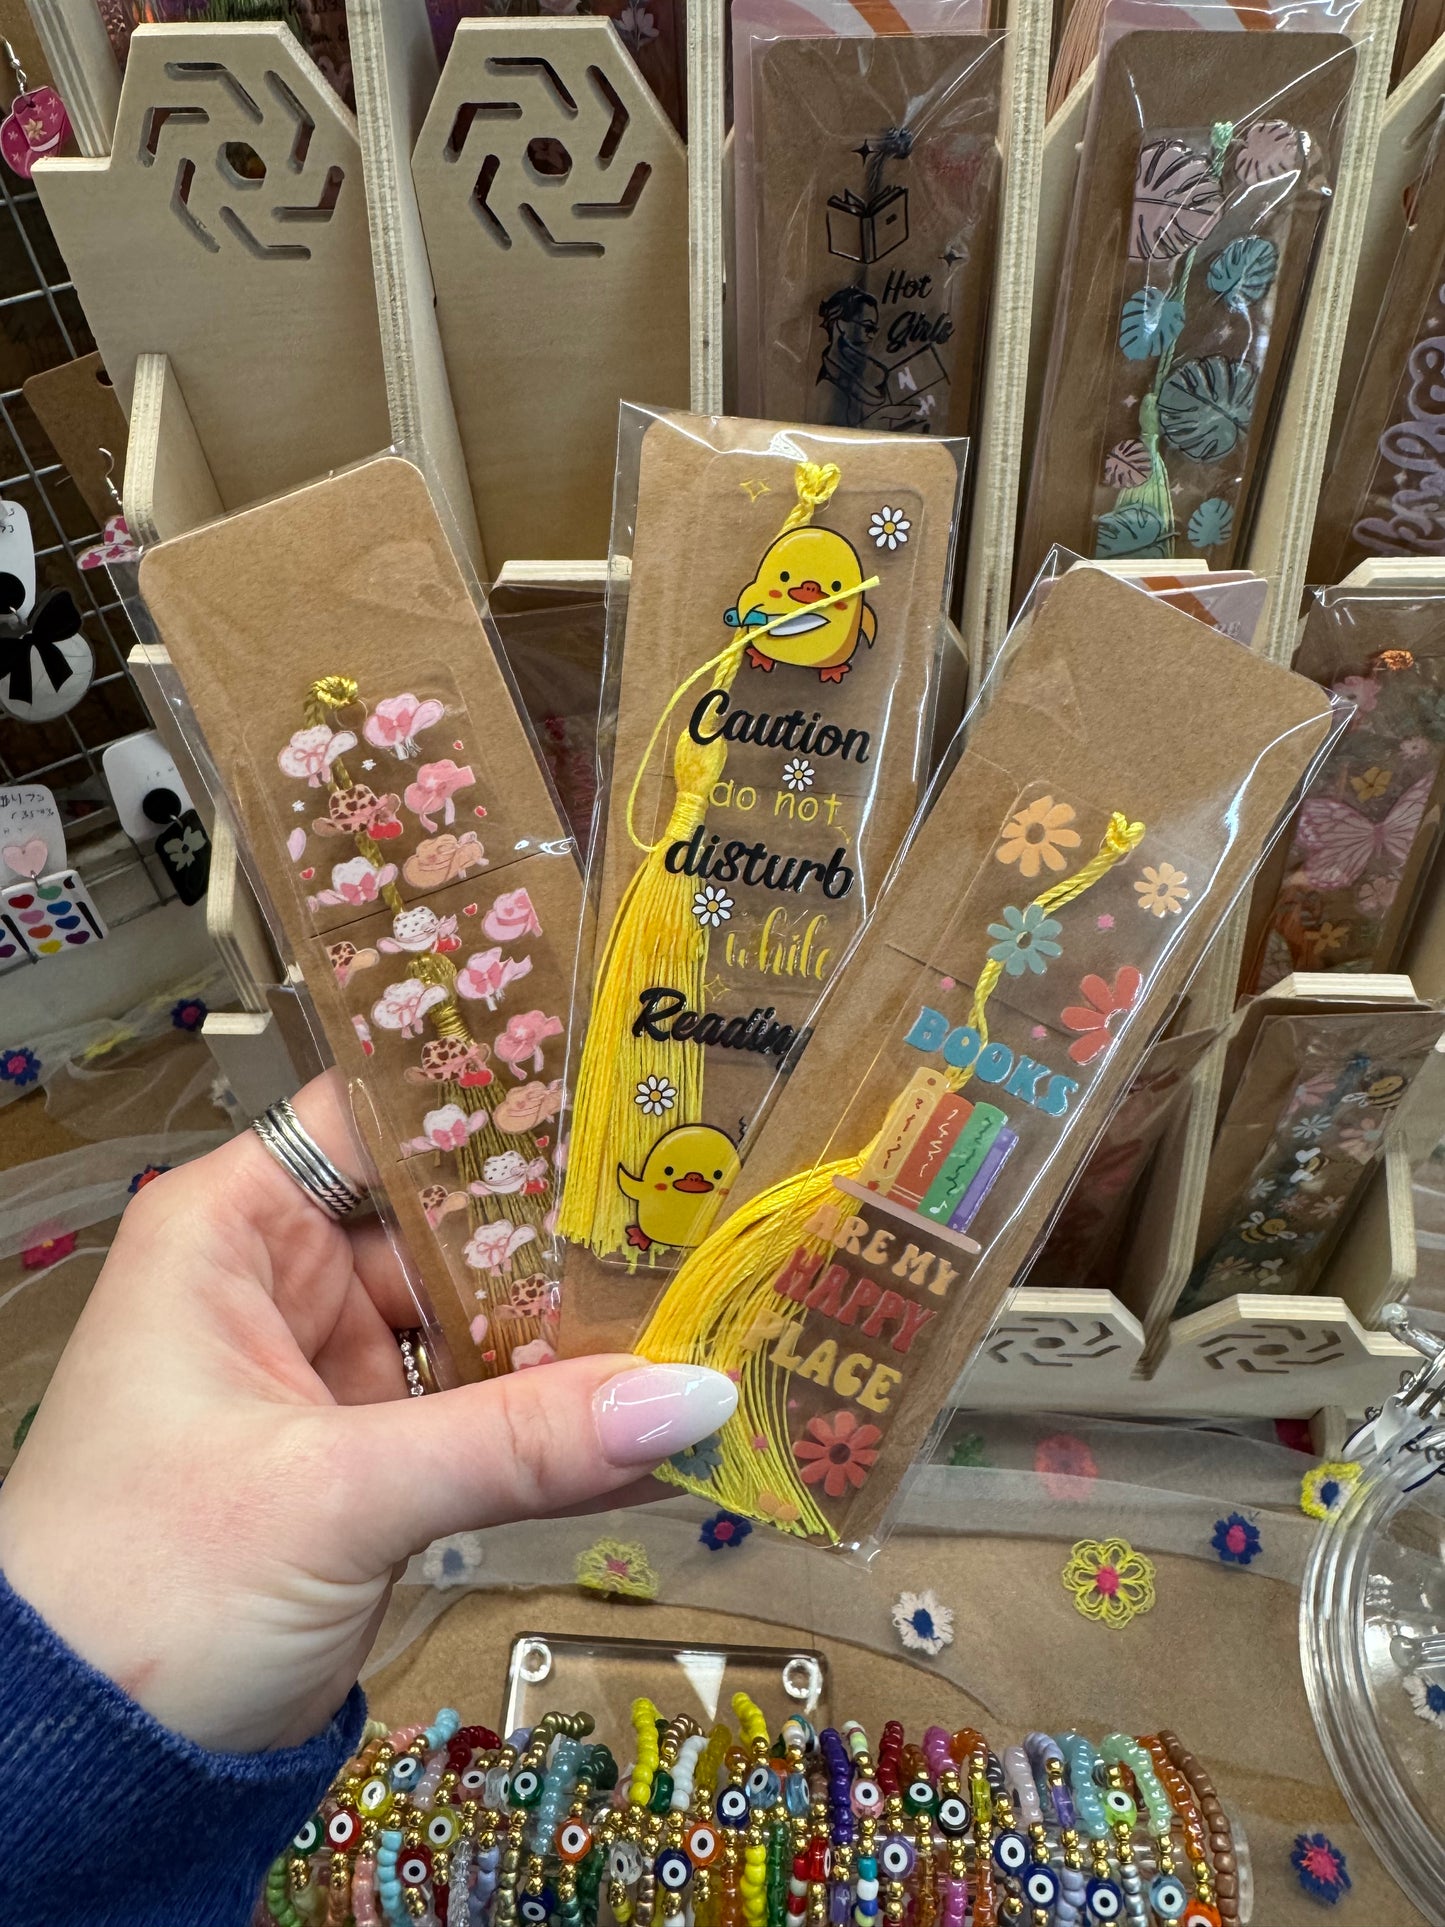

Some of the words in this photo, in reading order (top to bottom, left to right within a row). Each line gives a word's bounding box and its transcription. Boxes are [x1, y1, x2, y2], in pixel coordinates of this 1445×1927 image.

[881, 268, 933, 304] Hot
[886, 311, 955, 353] Girls
[688, 689, 870, 763] Caution
[709, 779, 757, 811] do
[774, 790, 842, 825] not
[664, 825, 854, 899] disturb
[904, 1006, 1079, 1117] BOOKS
[803, 1203, 896, 1265] ARE
[891, 1243, 960, 1296] MY
[773, 1246, 937, 1353] HAPPY
[740, 1308, 902, 1413] PLACE
